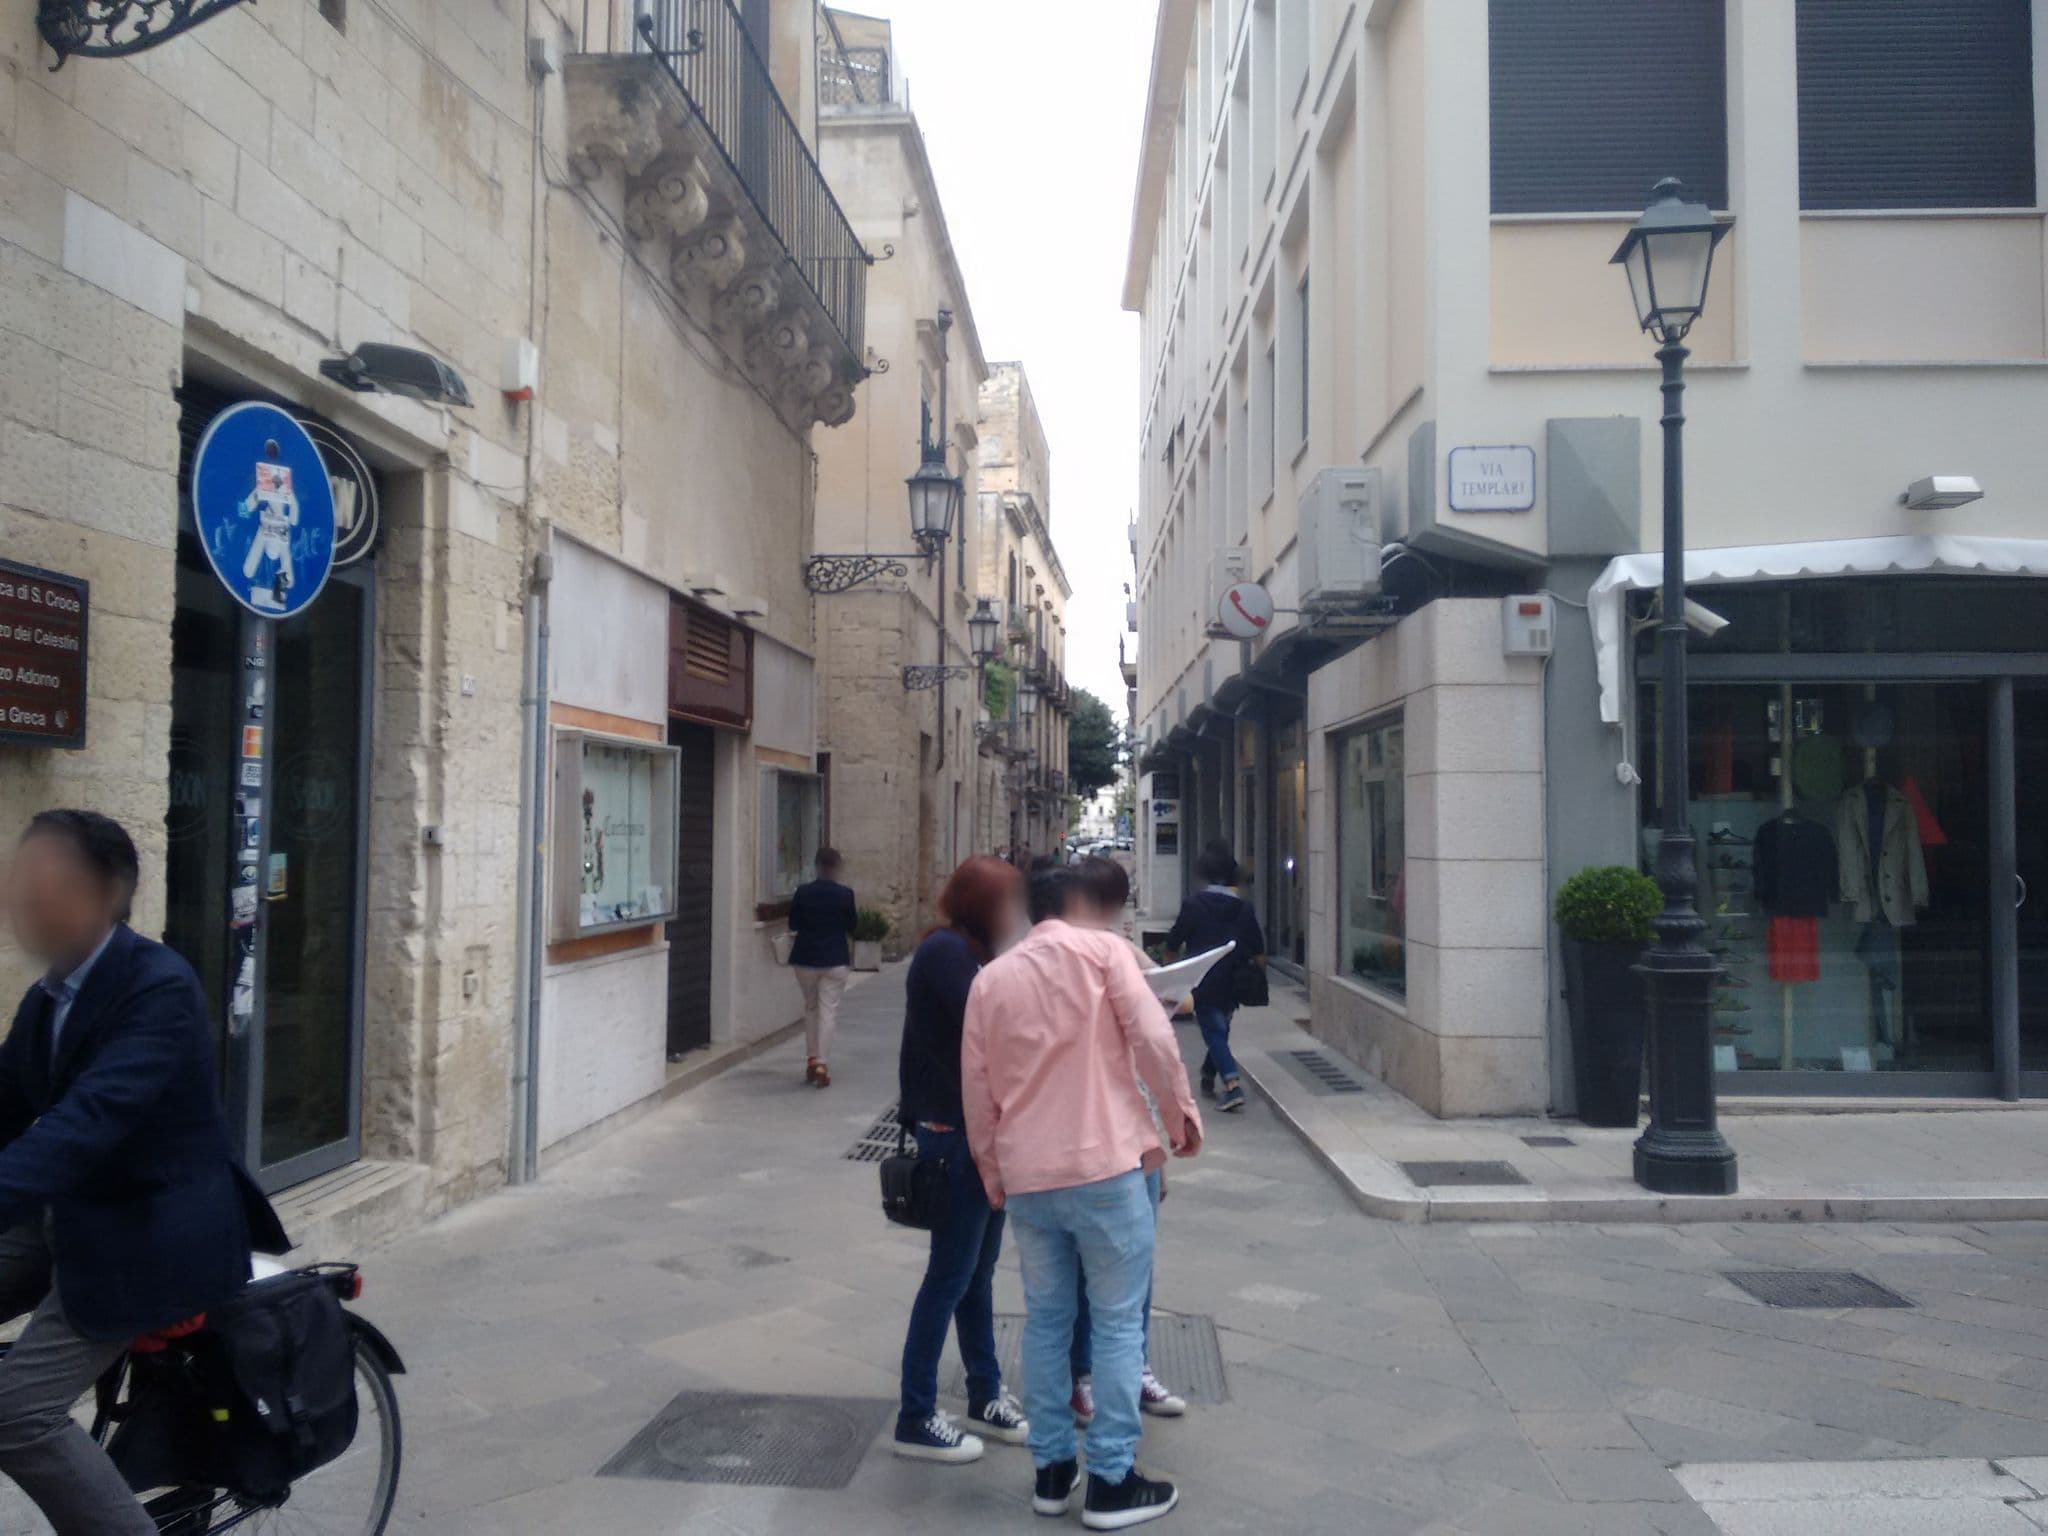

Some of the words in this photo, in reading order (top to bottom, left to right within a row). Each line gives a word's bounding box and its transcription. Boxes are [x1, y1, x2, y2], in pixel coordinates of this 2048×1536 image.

[1480, 463, 1504, 477] VIA
[1461, 481, 1525, 497] TEMPLARI
[17, 584, 29, 601] di
[45, 590, 80, 613] Croce
[14, 625, 32, 642] dei
[34, 628, 80, 651] Celestini
[16, 667, 60, 689] Adorno
[9, 706, 46, 727] Greca
